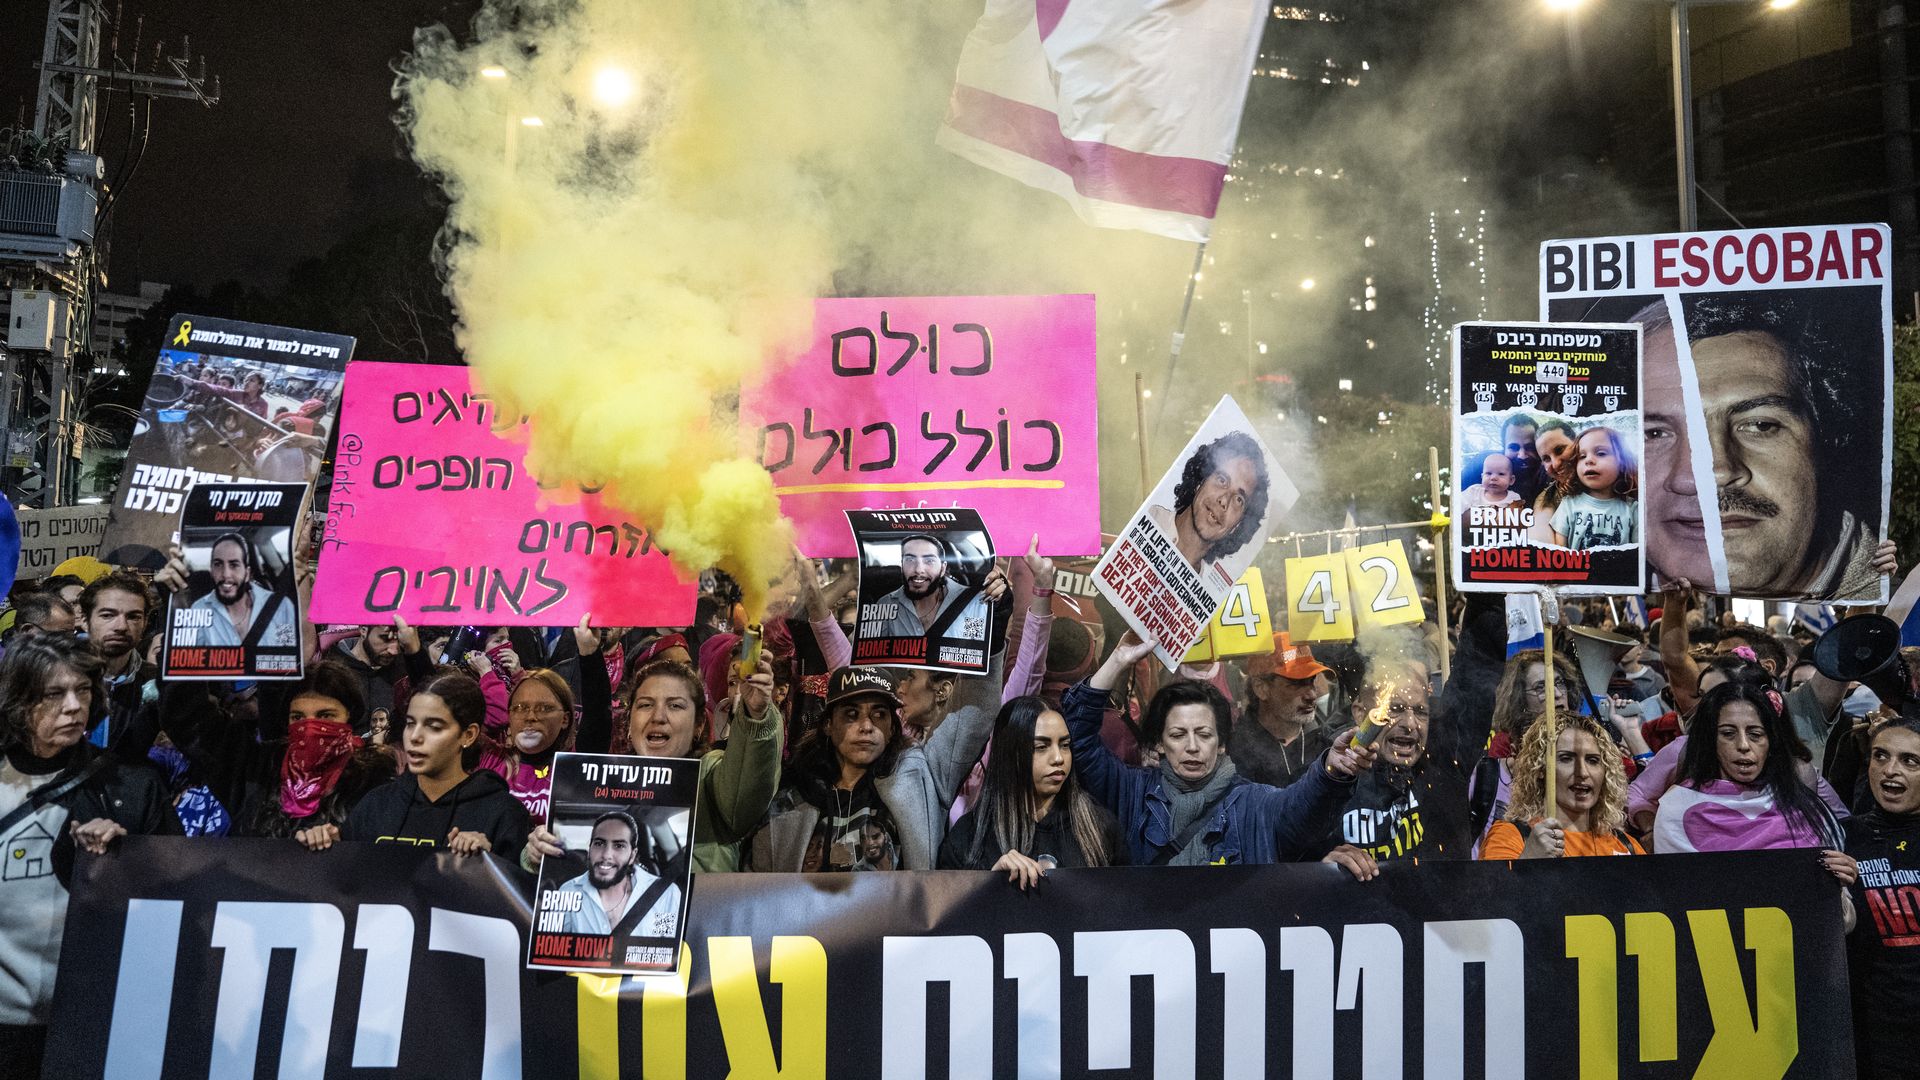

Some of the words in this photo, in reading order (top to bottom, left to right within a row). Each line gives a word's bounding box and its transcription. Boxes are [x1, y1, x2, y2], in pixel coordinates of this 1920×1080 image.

[1547, 241, 1635, 293] BIBI
[1654, 228, 1884, 287] ESCOBAR
[191, 329, 245, 346] המלחמה
[244, 336, 265, 348] את
[266, 338, 301, 353] לגמור
[1496, 332, 1536, 346] ביבס
[1539, 333, 1602, 347] משפחת
[300, 343, 341, 359] חייבים
[1491, 350, 1532, 360] החמאס
[1534, 351, 1561, 360] בשבי
[1563, 352, 1607, 363] מוחזקים
[1543, 365, 1565, 377] 440
[1568, 365, 1590, 376] מעל
[1472, 382, 1497, 392] KFIR
[1506, 383, 1549, 393] YARDEN
[1557, 384, 1588, 394] SHIRI
[1595, 385, 1627, 395] ARIEL
[373, 455, 514, 491] הופכים
[124, 487, 183, 514] כולנו
[208, 490, 224, 507] חי
[222, 490, 257, 510] עדיין
[254, 490, 284, 510] מתן
[890, 512, 926, 523] עדיין
[926, 512, 957, 524] מתן
[1470, 507, 1535, 527] BRING
[1469, 527, 1529, 547] THEM
[1137, 514, 1154, 534] MY
[1149, 529, 1171, 556] LIFE
[1166, 548, 1176, 562] IS
[1176, 562, 1195, 586] THE
[1189, 579, 1217, 614] HANDS
[1470, 549, 1531, 568] HOME
[1537, 550, 1591, 569] NOW!
[364, 558, 569, 616] לאויבים
[1100, 562, 1138, 608] DEATH
[1120, 539, 1132, 552] IF
[1128, 547, 1148, 572] THEY
[1143, 567, 1166, 594] DON'T
[1161, 589, 1180, 612] SIGN
[1174, 607, 1184, 619] A
[1180, 611, 1199, 637] DEAL
[1141, 542, 1171, 577] ISRAELI
[1165, 573, 1209, 624] GOVERNMENT
[1112, 550, 1137, 580] THEY
[1131, 576, 1153, 601] ARE
[1148, 594, 1181, 635] SIGNING
[1176, 628, 1193, 648] MY
[174, 608, 213, 628] BRING
[861, 603, 899, 621] BRING
[172, 628, 199, 646] HIM
[859, 621, 882, 639] HIM
[856, 639, 889, 658] HOME
[891, 637, 928, 657] NOW!
[170, 648, 207, 668] HOME
[208, 646, 245, 668] NOW!
[939, 651, 964, 663] FAMILIES
[964, 654, 983, 665] FORUM
[582, 763, 599, 781] חי
[601, 764, 640, 785] עדיין
[642, 766, 673, 788] מתן
[1857, 858, 1891, 873] BRING
[1860, 873, 1892, 888] THEM
[541, 890, 583, 912] BRING
[538, 911, 566, 933] HIM
[535, 934, 572, 956] HOME
[576, 935, 614, 960] NOW!
[625, 953, 652, 964] FAMILIES
[652, 953, 673, 965] FORUM
